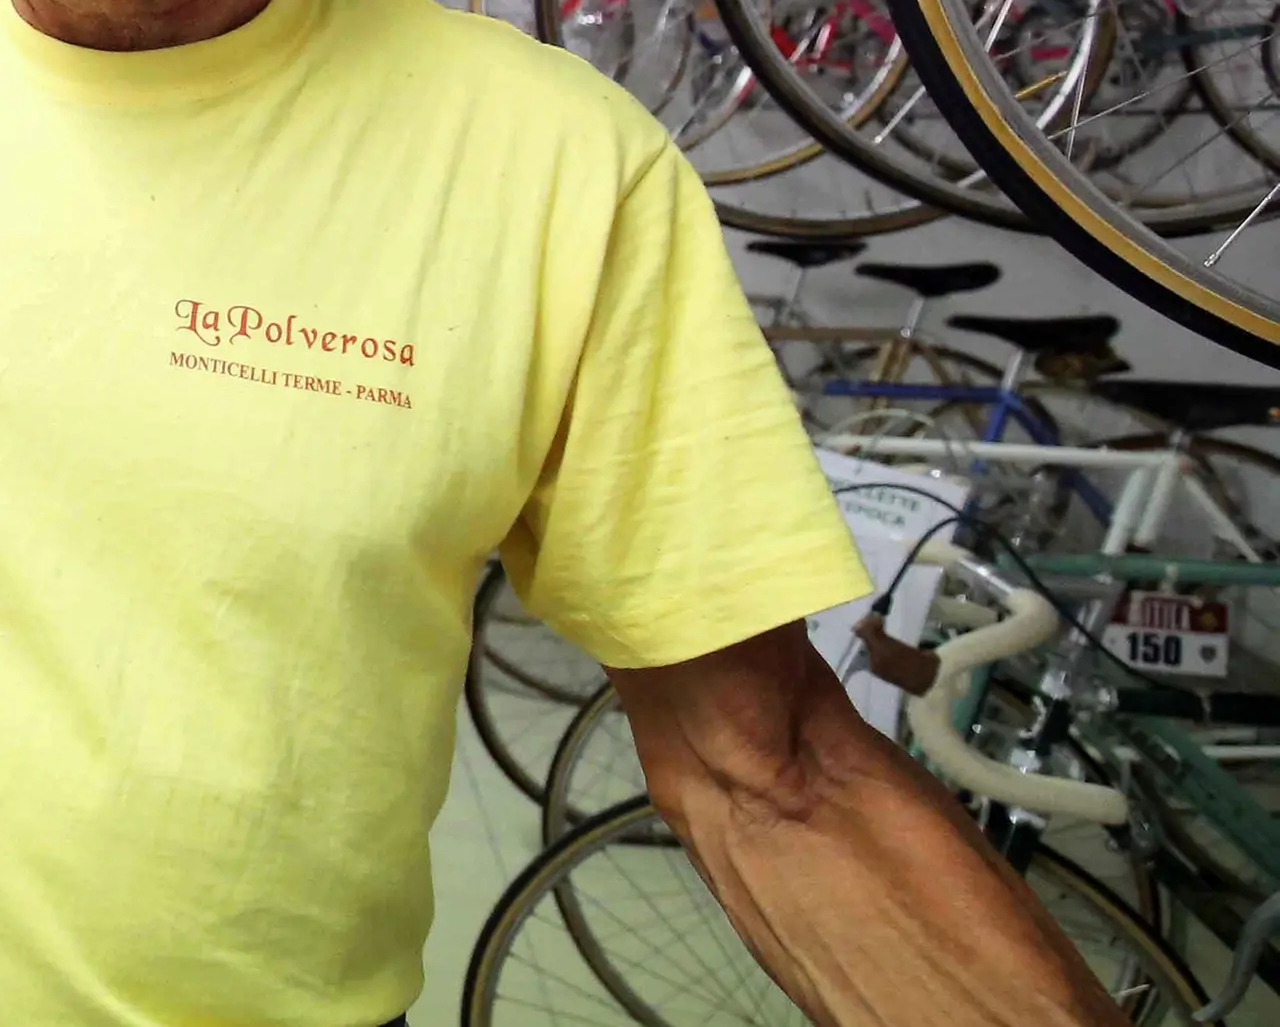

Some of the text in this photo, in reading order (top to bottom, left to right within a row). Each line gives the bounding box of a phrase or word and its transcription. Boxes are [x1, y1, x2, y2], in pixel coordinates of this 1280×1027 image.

[175, 299, 417, 367] La Polverosa
[169, 351, 278, 386] MONTICELLI
[282, 373, 342, 396] TERME
[356, 384, 413, 410] PARMA
[1127, 632, 1182, 666] 150
